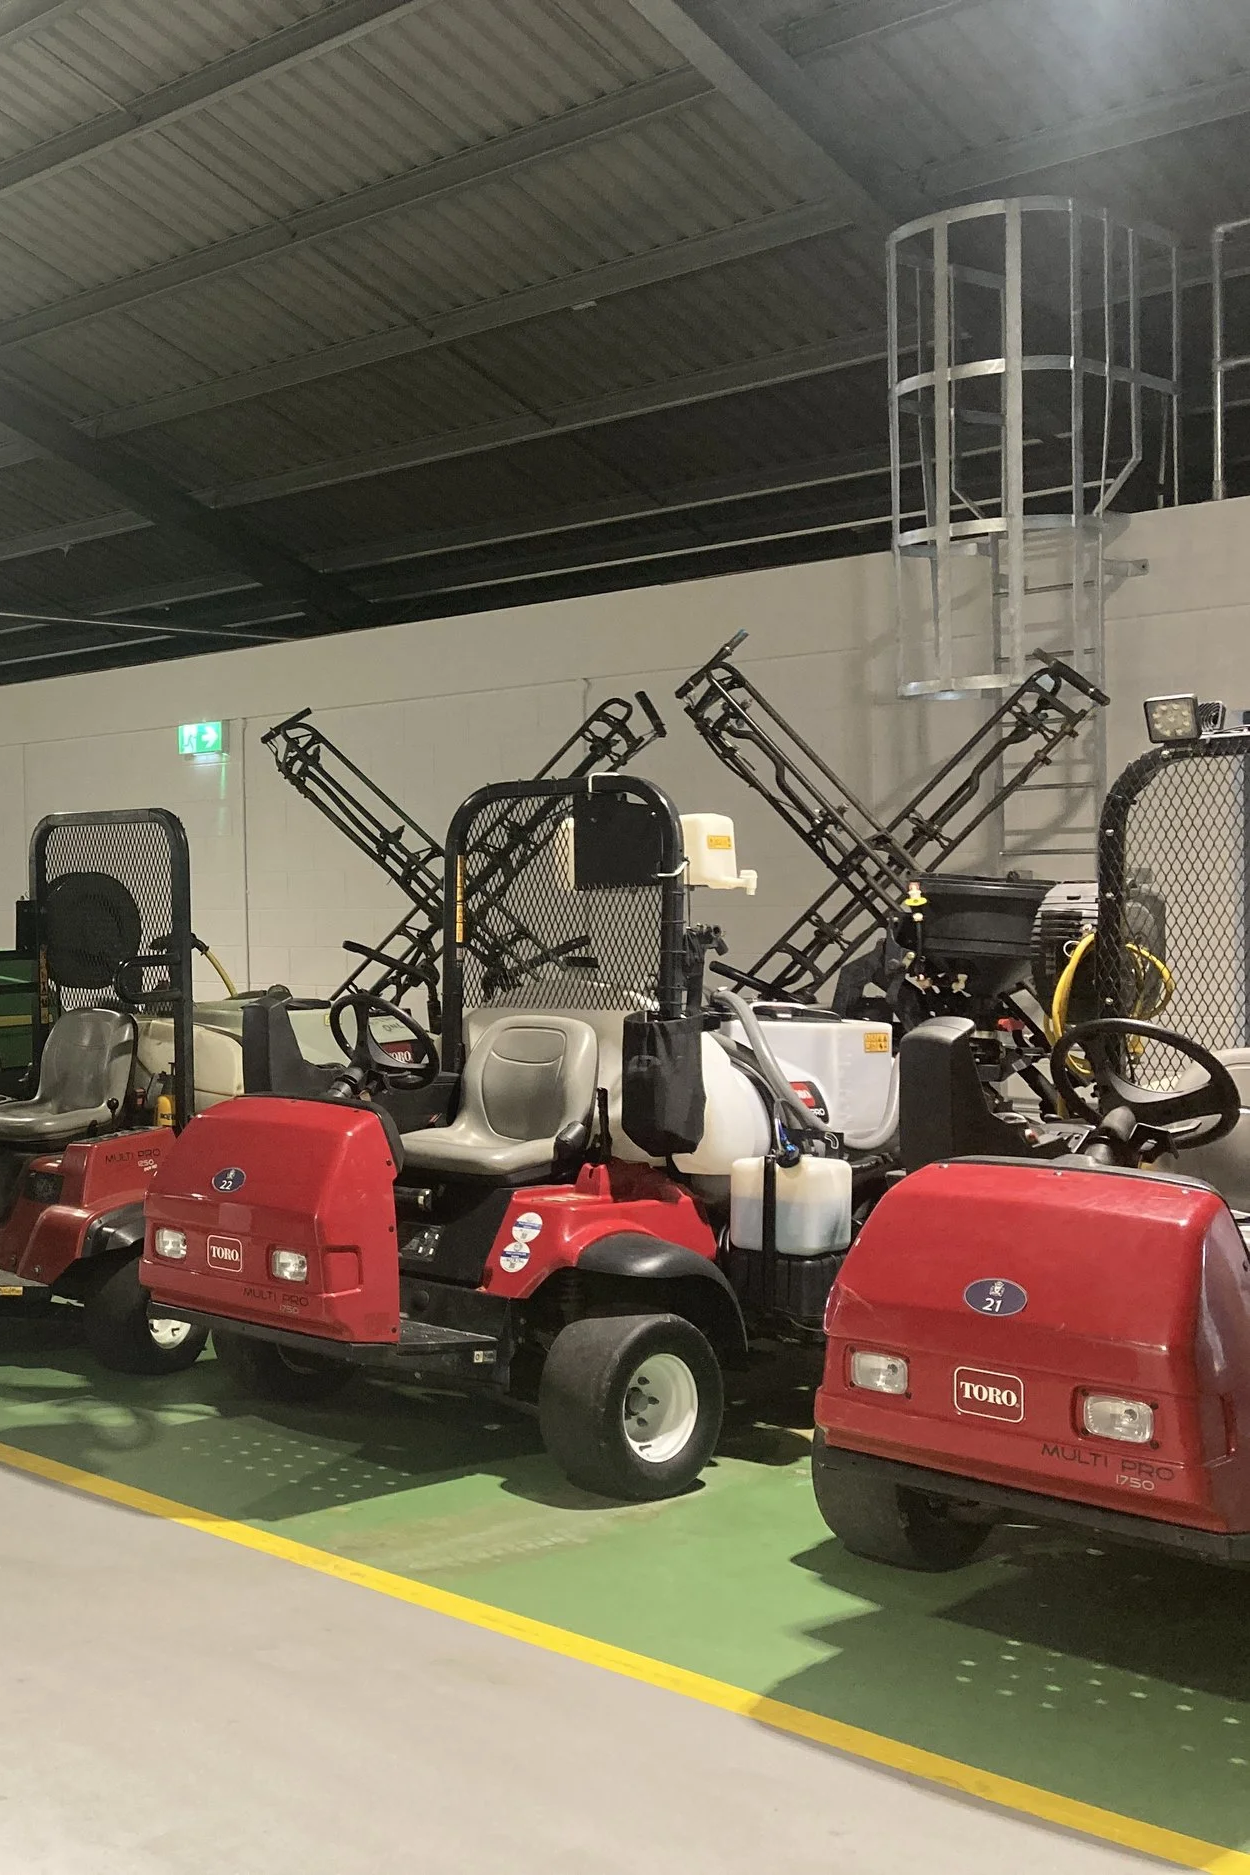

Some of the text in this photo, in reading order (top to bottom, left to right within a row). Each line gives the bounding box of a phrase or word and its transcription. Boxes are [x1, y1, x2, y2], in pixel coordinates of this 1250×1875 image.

[390, 1050, 411, 1063] ORO
[138, 1148, 161, 1158] PRO
[220, 1179, 233, 1190] 22
[211, 1245, 240, 1262] TORO
[243, 1287, 310, 1307] MULTI PRO
[982, 1297, 1002, 1312] 21
[960, 1381, 1018, 1407] TORO
[1041, 1443, 1174, 1481] MULTI PRO
[1116, 1474, 1155, 1491] 1750
